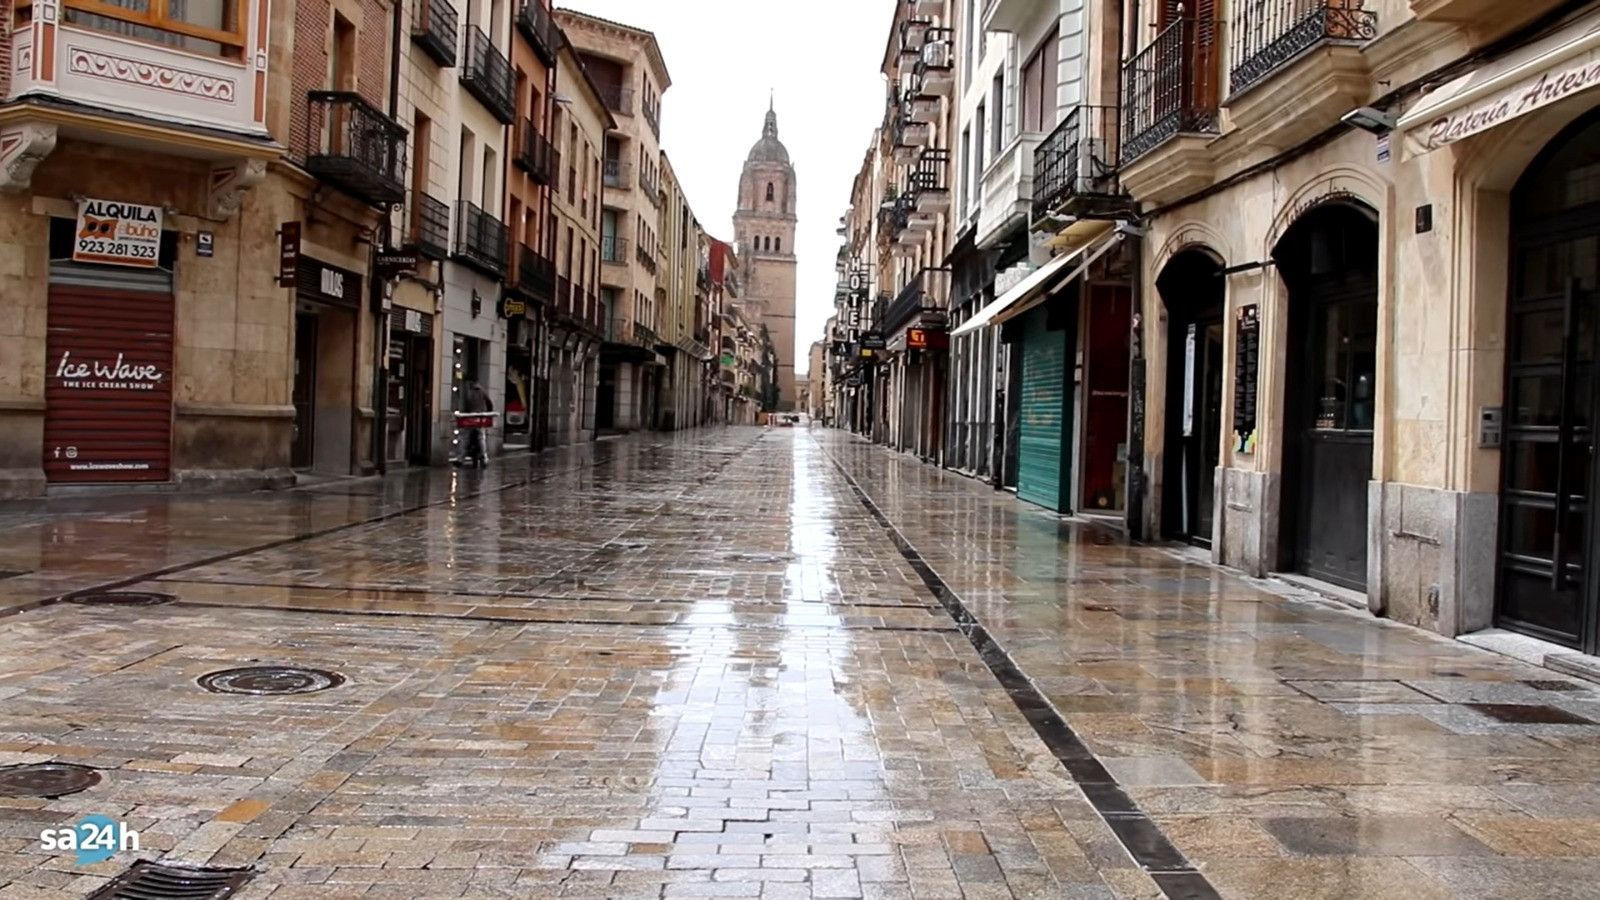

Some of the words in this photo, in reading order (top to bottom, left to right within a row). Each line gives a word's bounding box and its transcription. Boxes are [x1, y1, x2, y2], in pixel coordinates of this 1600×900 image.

[1427, 100, 1509, 150] Platería
[84, 202, 157, 222] ALQUILA
[79, 239, 105, 253] 923
[107, 242, 129, 255] 281
[130, 244, 156, 258] 323
[849, 257, 860, 343] HOTEL
[56, 350, 91, 377] Ice
[94, 352, 163, 380] Wave
[129, 382, 154, 390] SHOW
